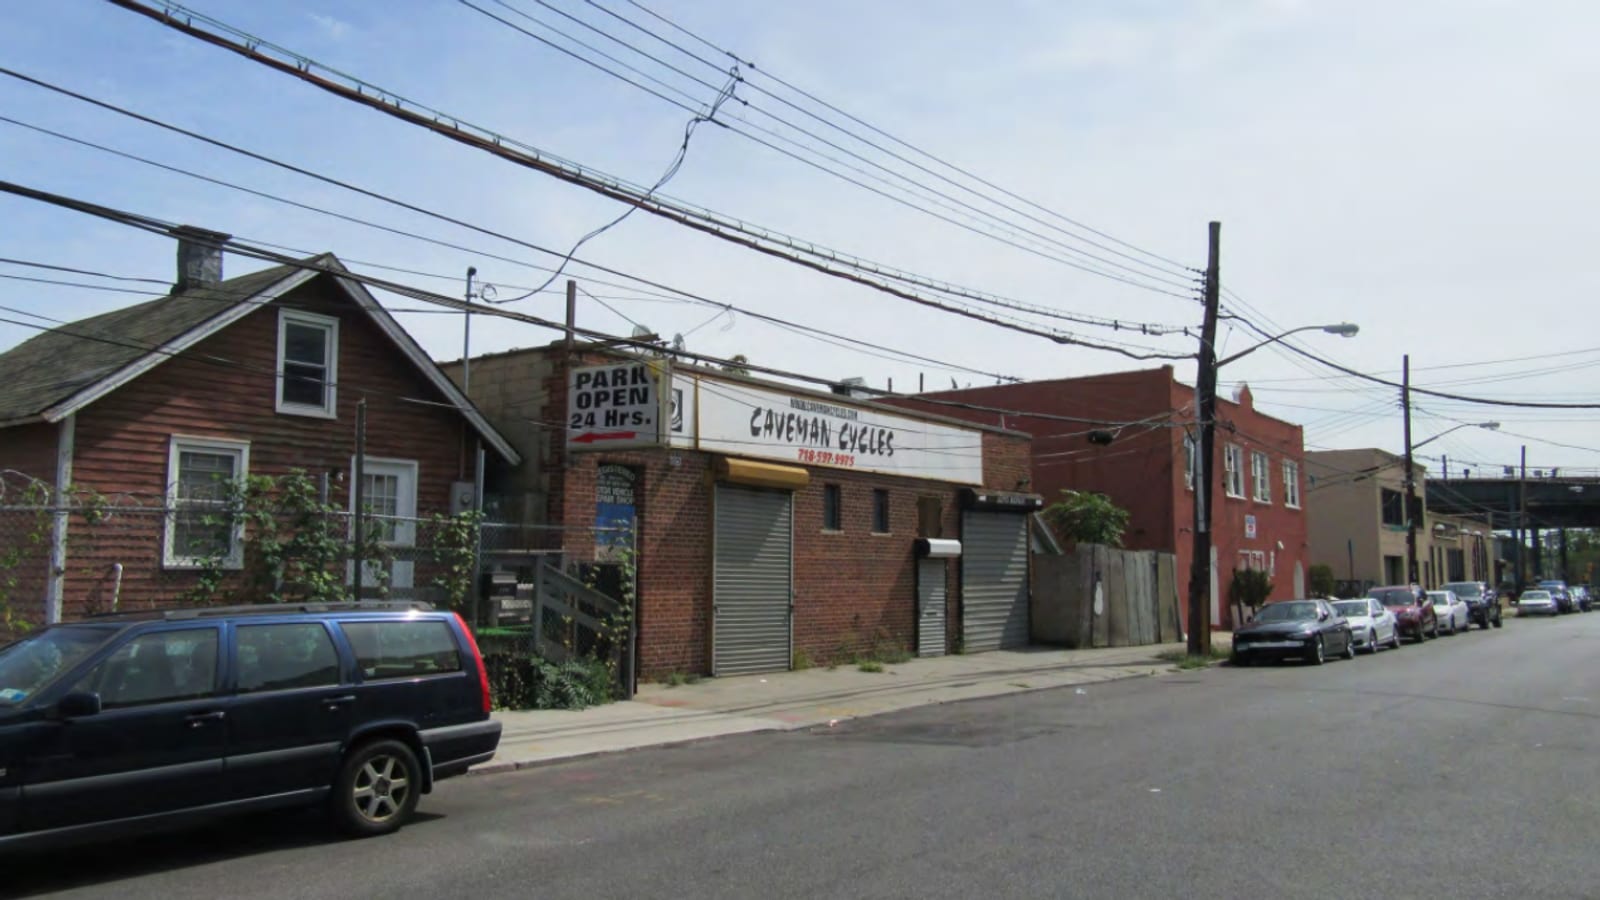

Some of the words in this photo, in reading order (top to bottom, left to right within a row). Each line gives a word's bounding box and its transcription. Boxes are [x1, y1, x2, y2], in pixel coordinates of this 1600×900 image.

[576, 366, 649, 390] PARK
[576, 387, 649, 410] OPEN
[570, 412, 596, 429] 24
[604, 409, 652, 427] Hrs.
[750, 407, 832, 448] CAVEMAN
[838, 422, 895, 457] CYCLES
[597, 465, 635, 480] EGISTERED
